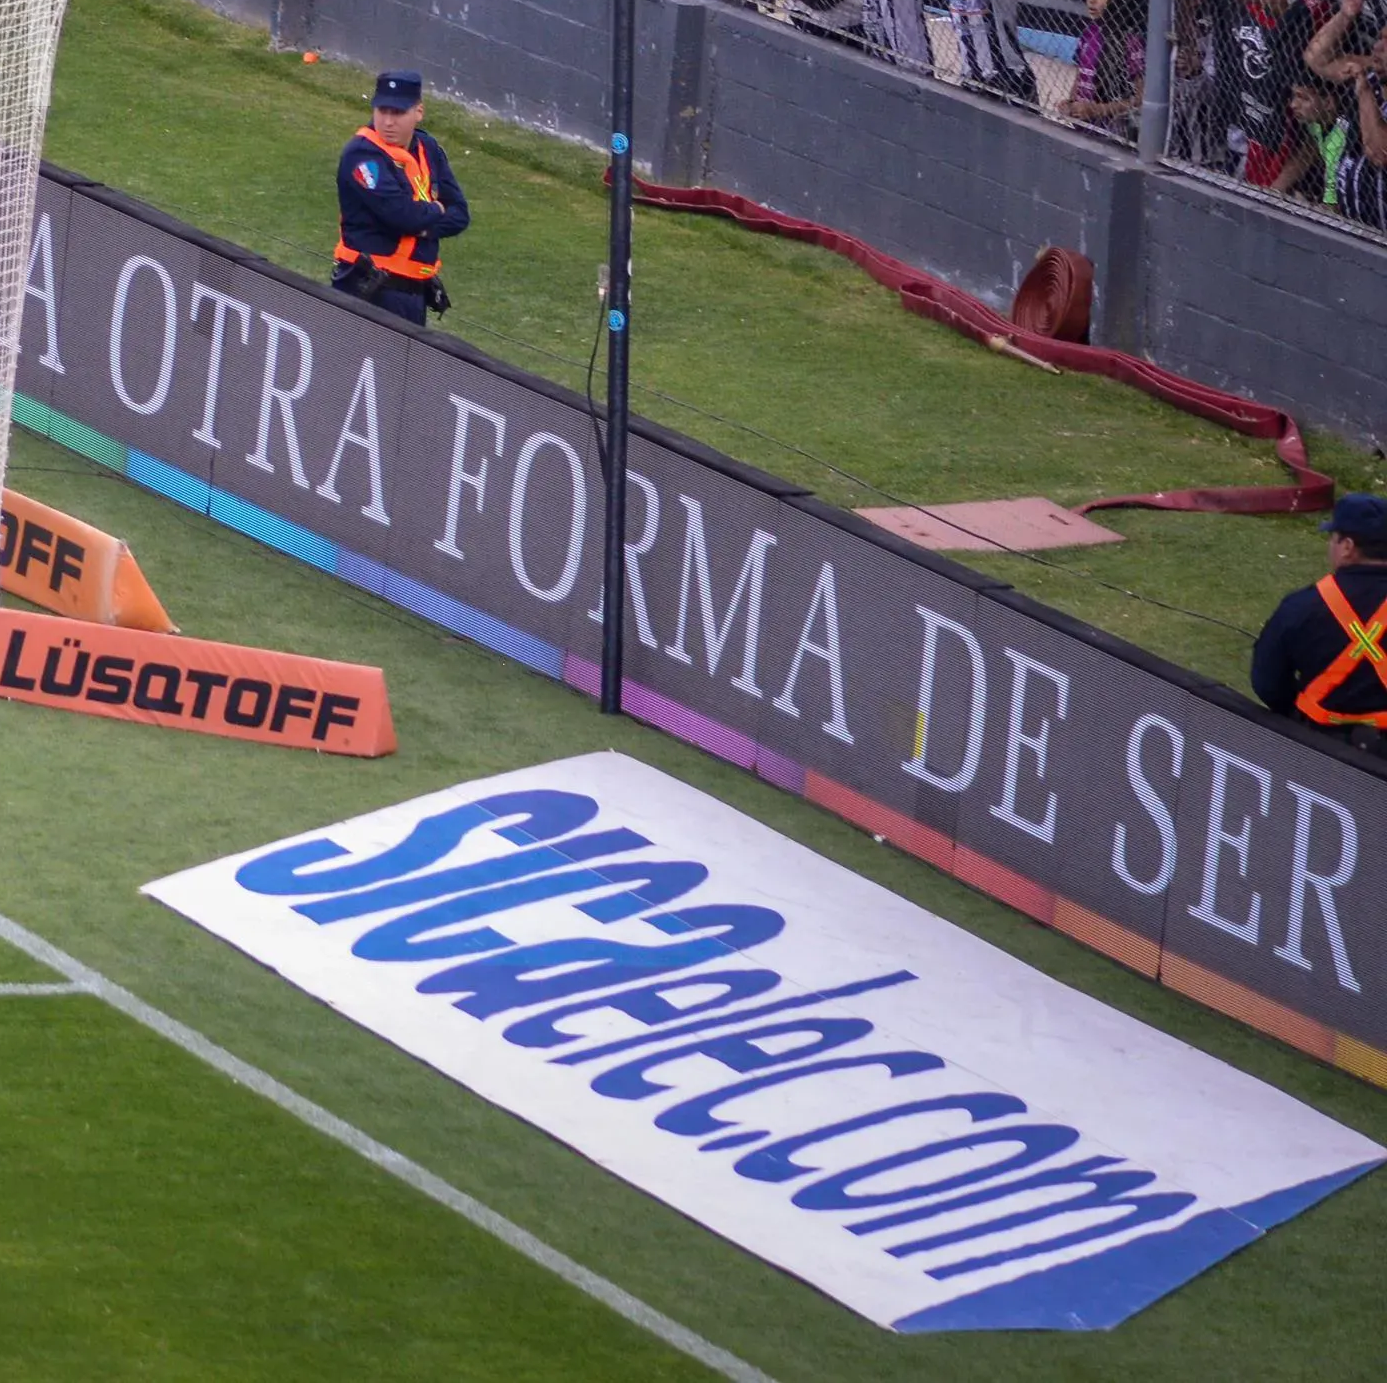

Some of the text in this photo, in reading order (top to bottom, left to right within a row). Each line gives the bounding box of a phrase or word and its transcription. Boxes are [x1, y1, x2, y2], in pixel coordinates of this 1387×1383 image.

[0, 628, 360, 741] LÜSQTOFF
[108, 254, 391, 527] OTRA
[433, 394, 855, 745] FORMA
[901, 604, 1071, 847] DE
[1111, 713, 1362, 994] SER
